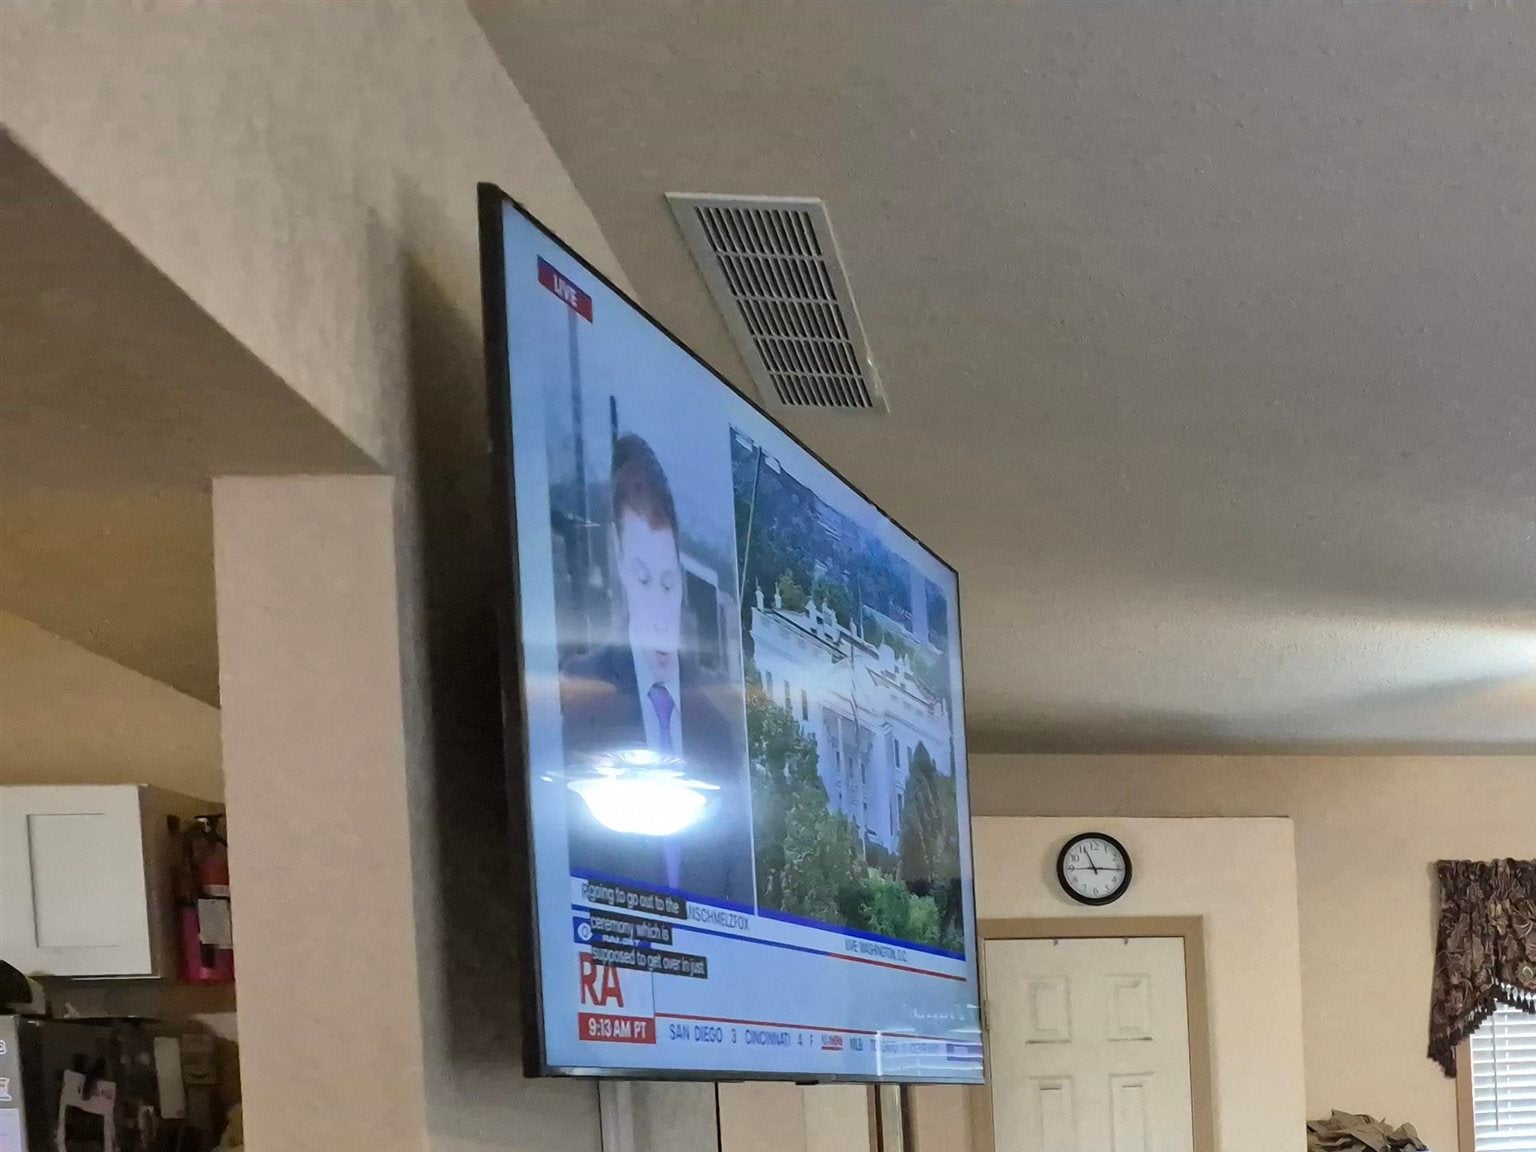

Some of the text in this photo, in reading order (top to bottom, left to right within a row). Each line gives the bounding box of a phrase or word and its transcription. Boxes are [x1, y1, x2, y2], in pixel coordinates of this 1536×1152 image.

[588, 1018, 647, 1039] 9:13 AM PT
[669, 1023, 690, 1041] SAN
[694, 1025, 723, 1043] DIEGO
[731, 1028, 738, 1044] 3
